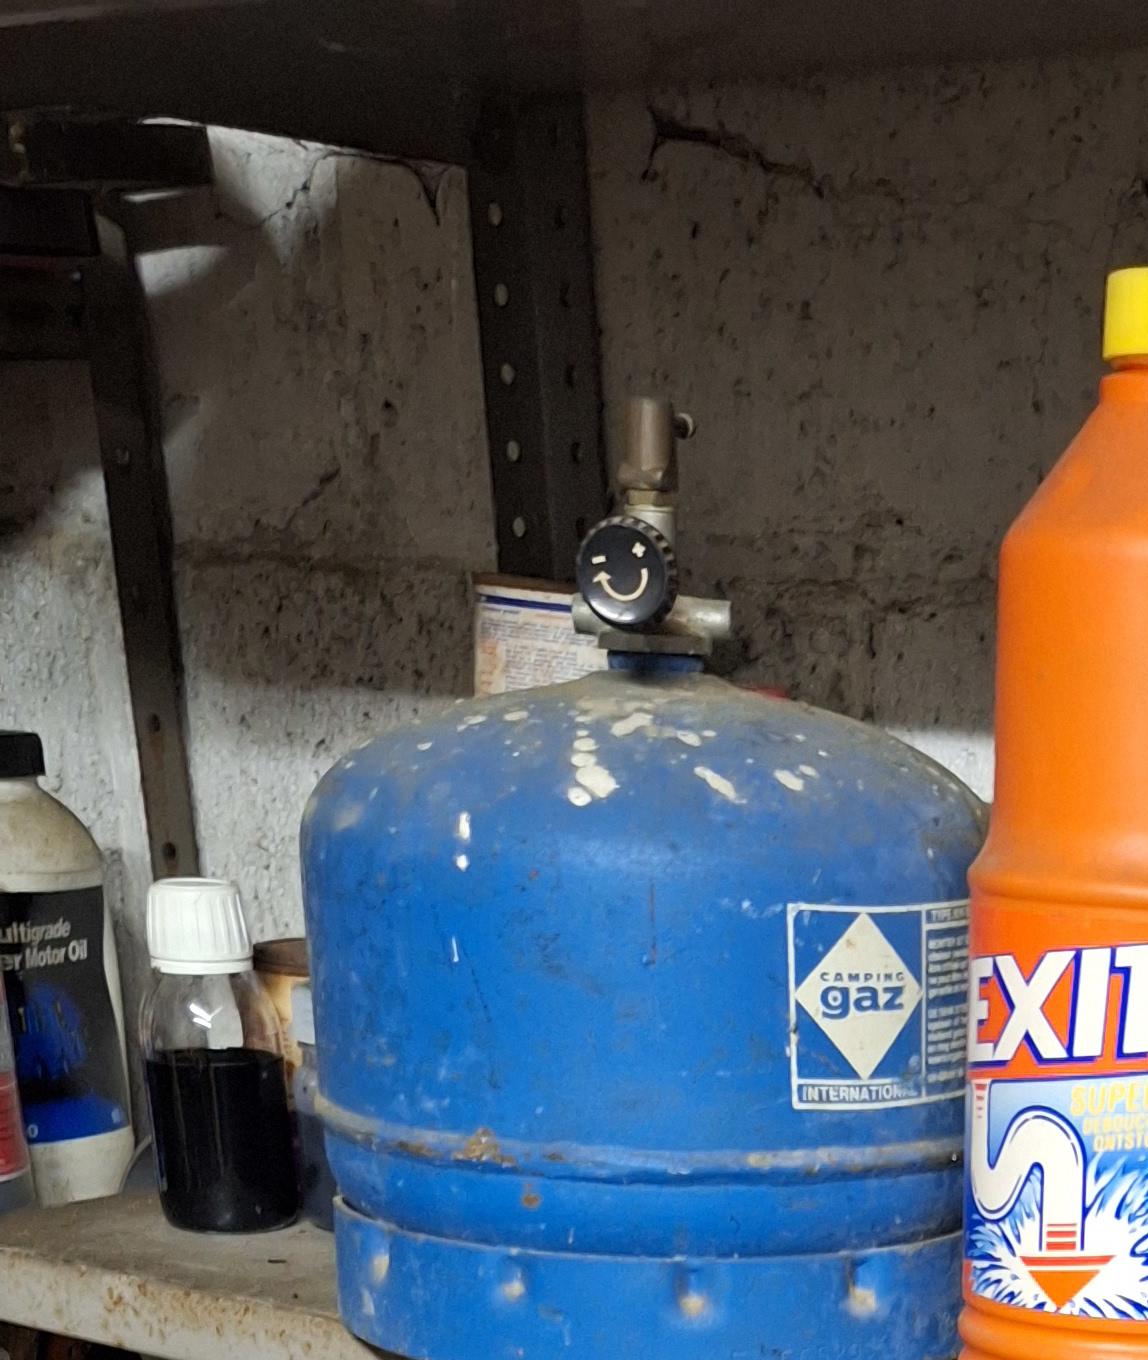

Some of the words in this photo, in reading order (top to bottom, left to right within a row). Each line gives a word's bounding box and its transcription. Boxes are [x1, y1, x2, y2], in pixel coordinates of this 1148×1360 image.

[0, 917, 72, 945] ultigrade
[25, 945, 65, 971] Motor
[68, 938, 88, 963] Oil
[820, 971, 905, 983] CAMPING
[820, 984, 905, 1020] gaz
